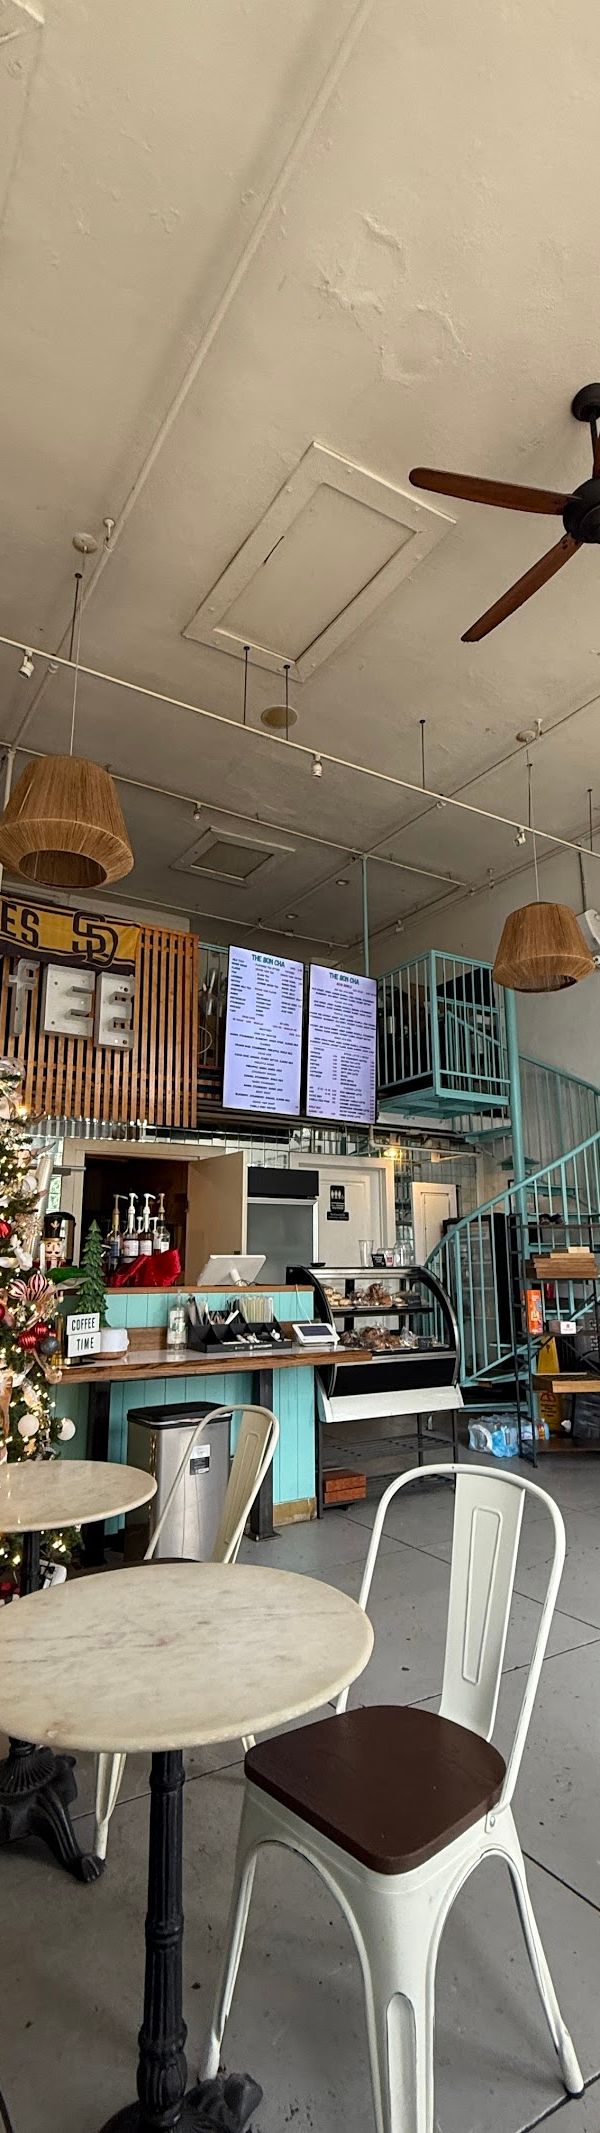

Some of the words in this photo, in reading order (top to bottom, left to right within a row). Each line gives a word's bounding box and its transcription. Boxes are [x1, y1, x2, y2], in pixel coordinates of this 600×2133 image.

[72, 910, 118, 968] SD
[252, 954, 262, 962] THE
[274, 959, 285, 968] CHA
[329, 972, 339, 981] THE
[349, 977, 360, 986] CHA
[71, 1317, 96, 1332] COFFEE
[76, 1337, 94, 1351] TIME
